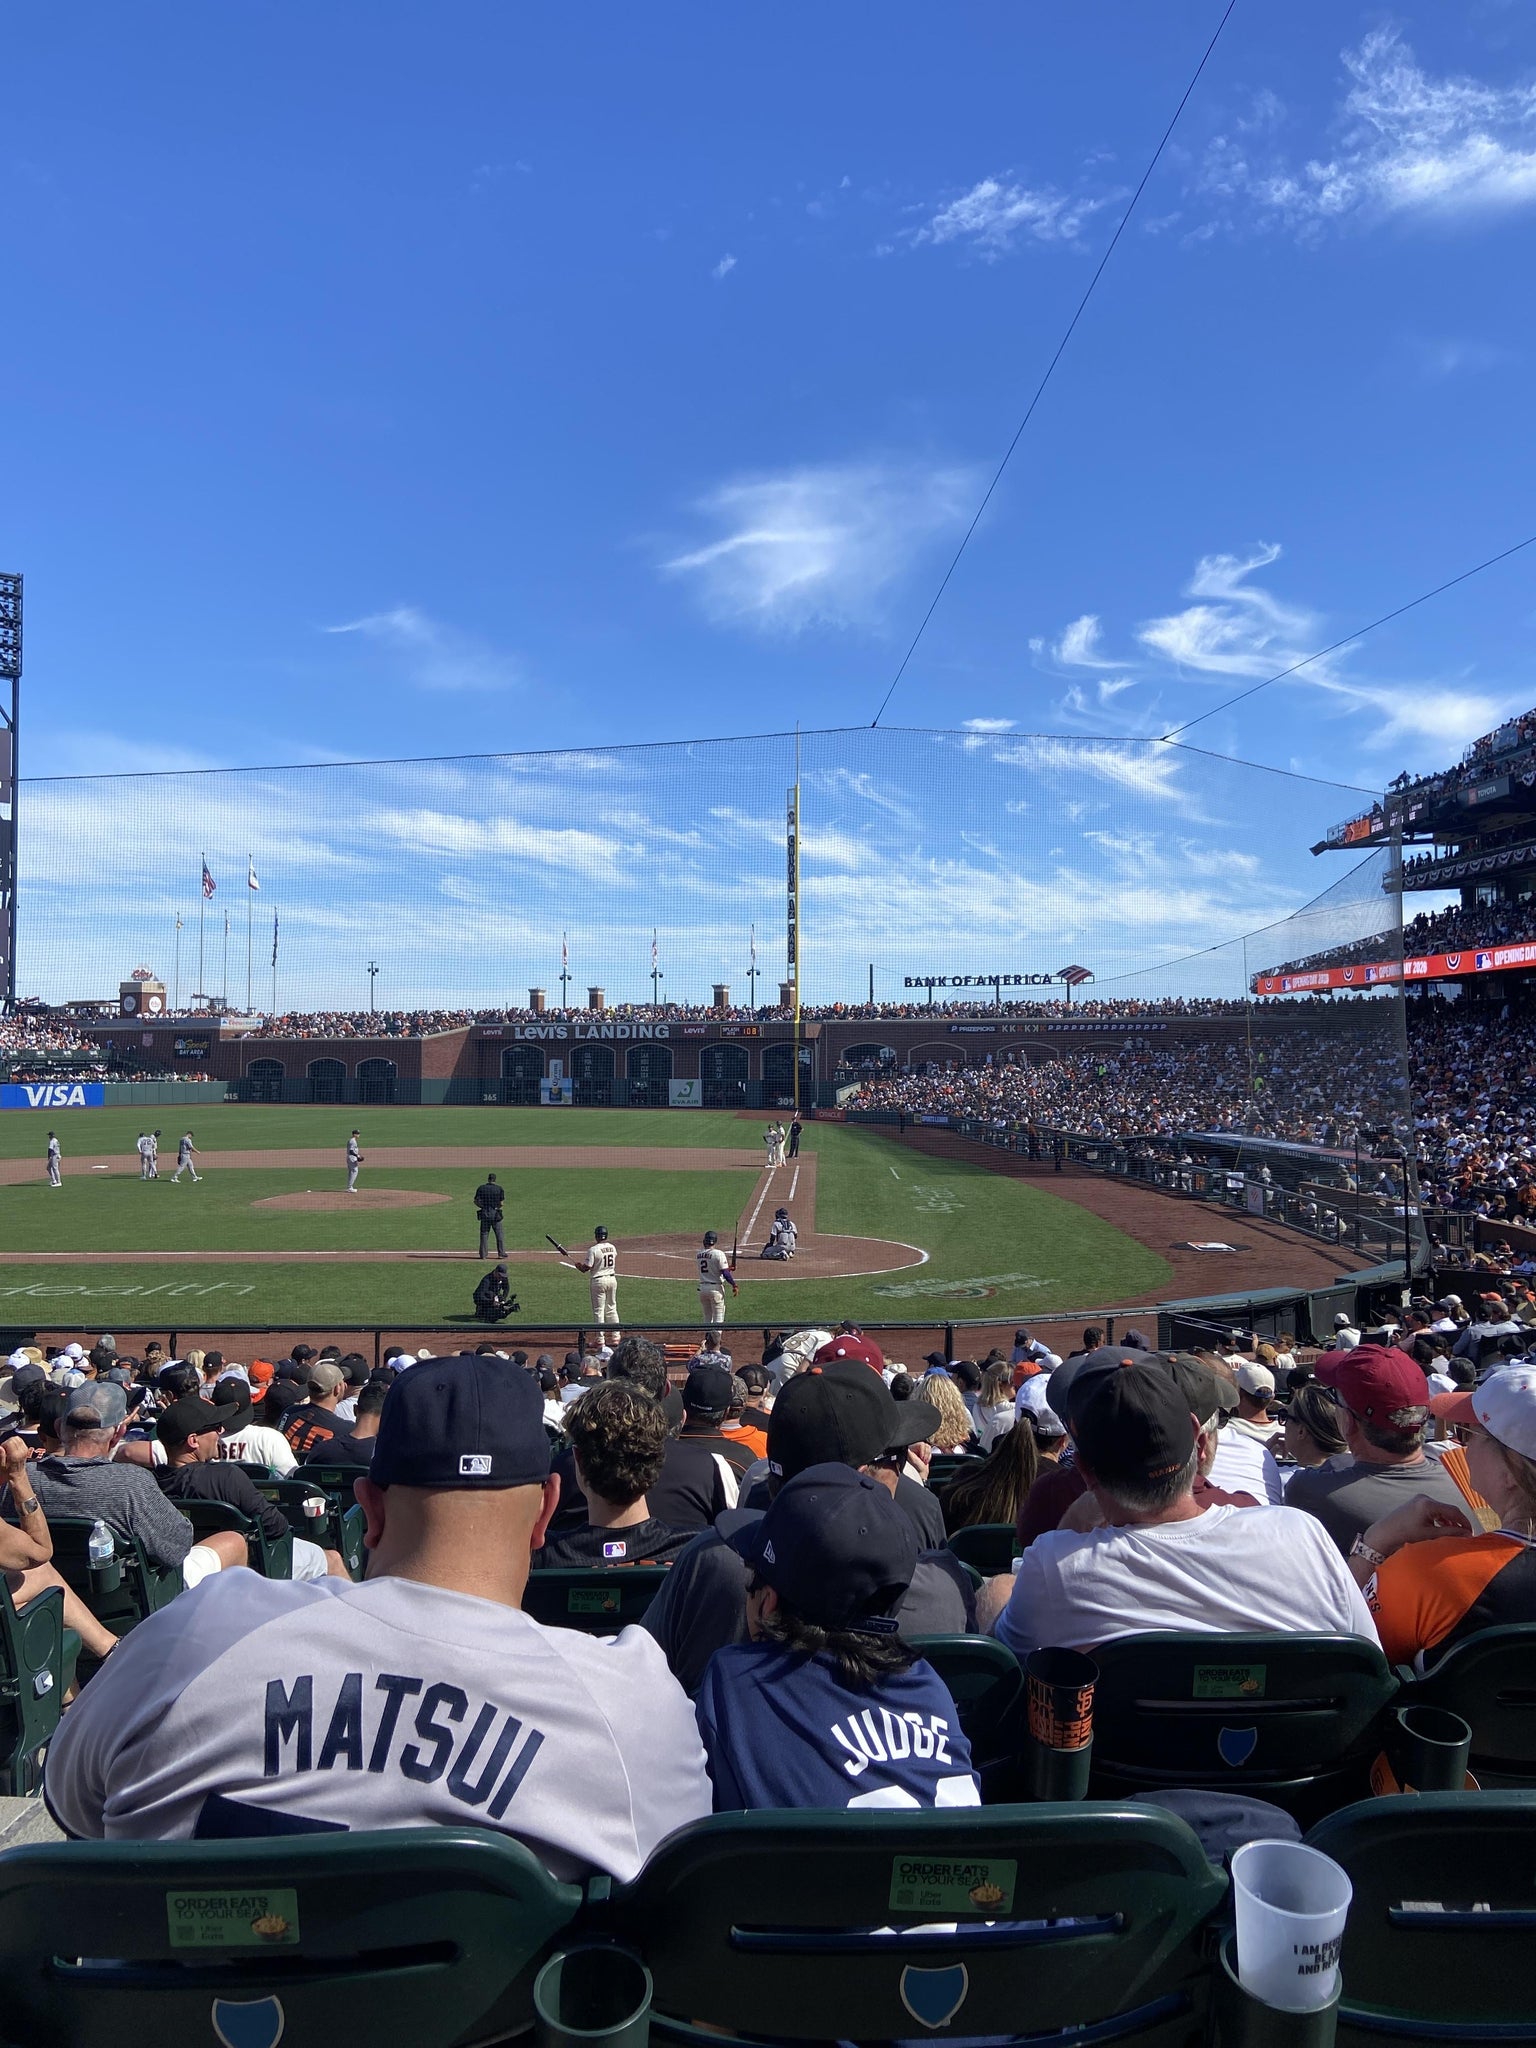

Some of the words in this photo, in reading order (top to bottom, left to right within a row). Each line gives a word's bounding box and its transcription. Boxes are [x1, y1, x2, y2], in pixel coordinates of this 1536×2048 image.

[1477, 785, 1497, 799] TOYOTA
[1494, 946, 1525, 966] OPENING
[1525, 945, 1536, 961] DA
[904, 976, 947, 988] BANK
[951, 975, 972, 987] OF
[976, 973, 1052, 987] AMERICA
[574, 1024, 670, 1039] LANDING
[743, 1027, 757, 1035] 108
[20, 1085, 86, 1107] VISA
[223, 1092, 239, 1100] 415
[483, 1093, 497, 1101] 365
[777, 1097, 795, 1106] 309
[603, 1254, 614, 1268] 16
[700, 1260, 709, 1274] 2
[263, 1672, 546, 1821] MATSUI
[830, 1706, 953, 1777] JUDGE
[899, 1862, 952, 1876] ORDER
[954, 1864, 990, 1878] EATS
[901, 1874, 918, 1884] TO
[919, 1874, 955, 1886] YOUR
[958, 1875, 988, 1888] SEAT
[174, 1898, 229, 1911] ORDER
[230, 1896, 269, 1909] EATS
[177, 1909, 195, 1920] TO
[199, 1908, 233, 1919] YOUR
[236, 1908, 270, 1919] SEAT
[1293, 1944, 1298, 1955] I
[1301, 1944, 1320, 1955] AM
[1314, 1953, 1326, 1964] BE
[1297, 1964, 1320, 1975] AND
